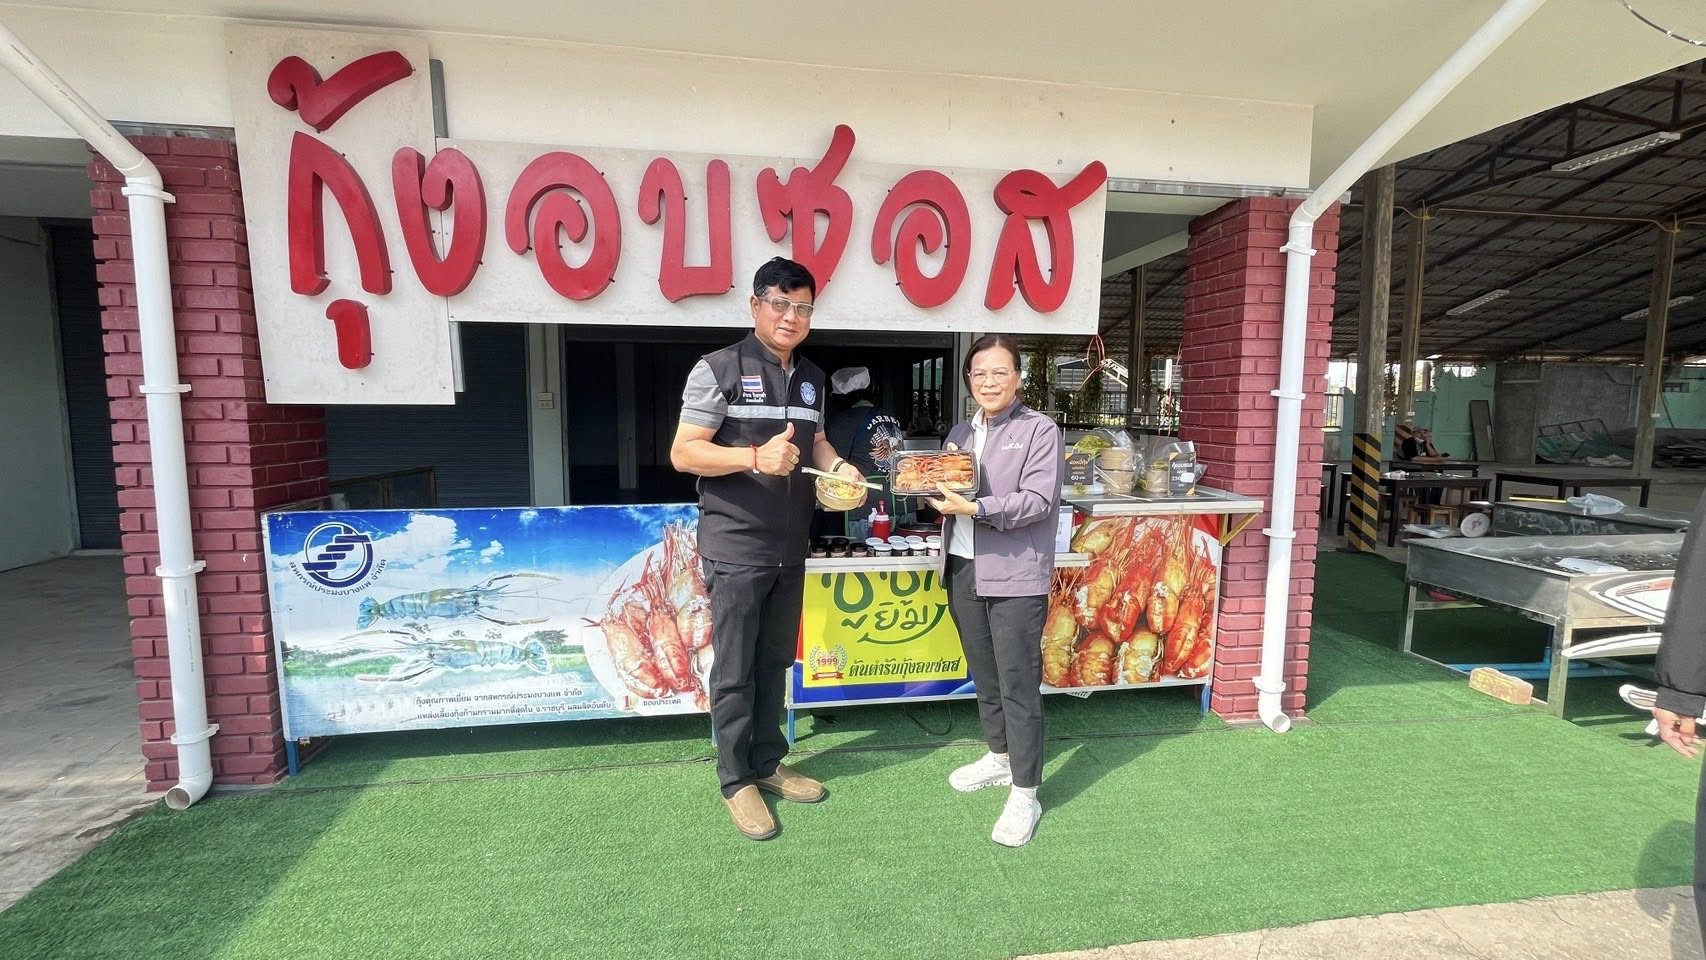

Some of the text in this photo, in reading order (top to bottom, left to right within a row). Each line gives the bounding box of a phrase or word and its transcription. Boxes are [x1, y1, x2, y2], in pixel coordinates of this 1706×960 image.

[268, 50, 1107, 371] กุ้งอบซอส
[371, 558, 387, 580] จำกัด
[874, 600, 928, 630] ยิ้ม
[816, 656, 838, 665] 1999
[848, 656, 962, 679] ต้นตำรับกุ้งอบซอส
[416, 692, 472, 707] กุ้งคุณภาพเยี่ยม
[563, 688, 583, 697] จำกัด
